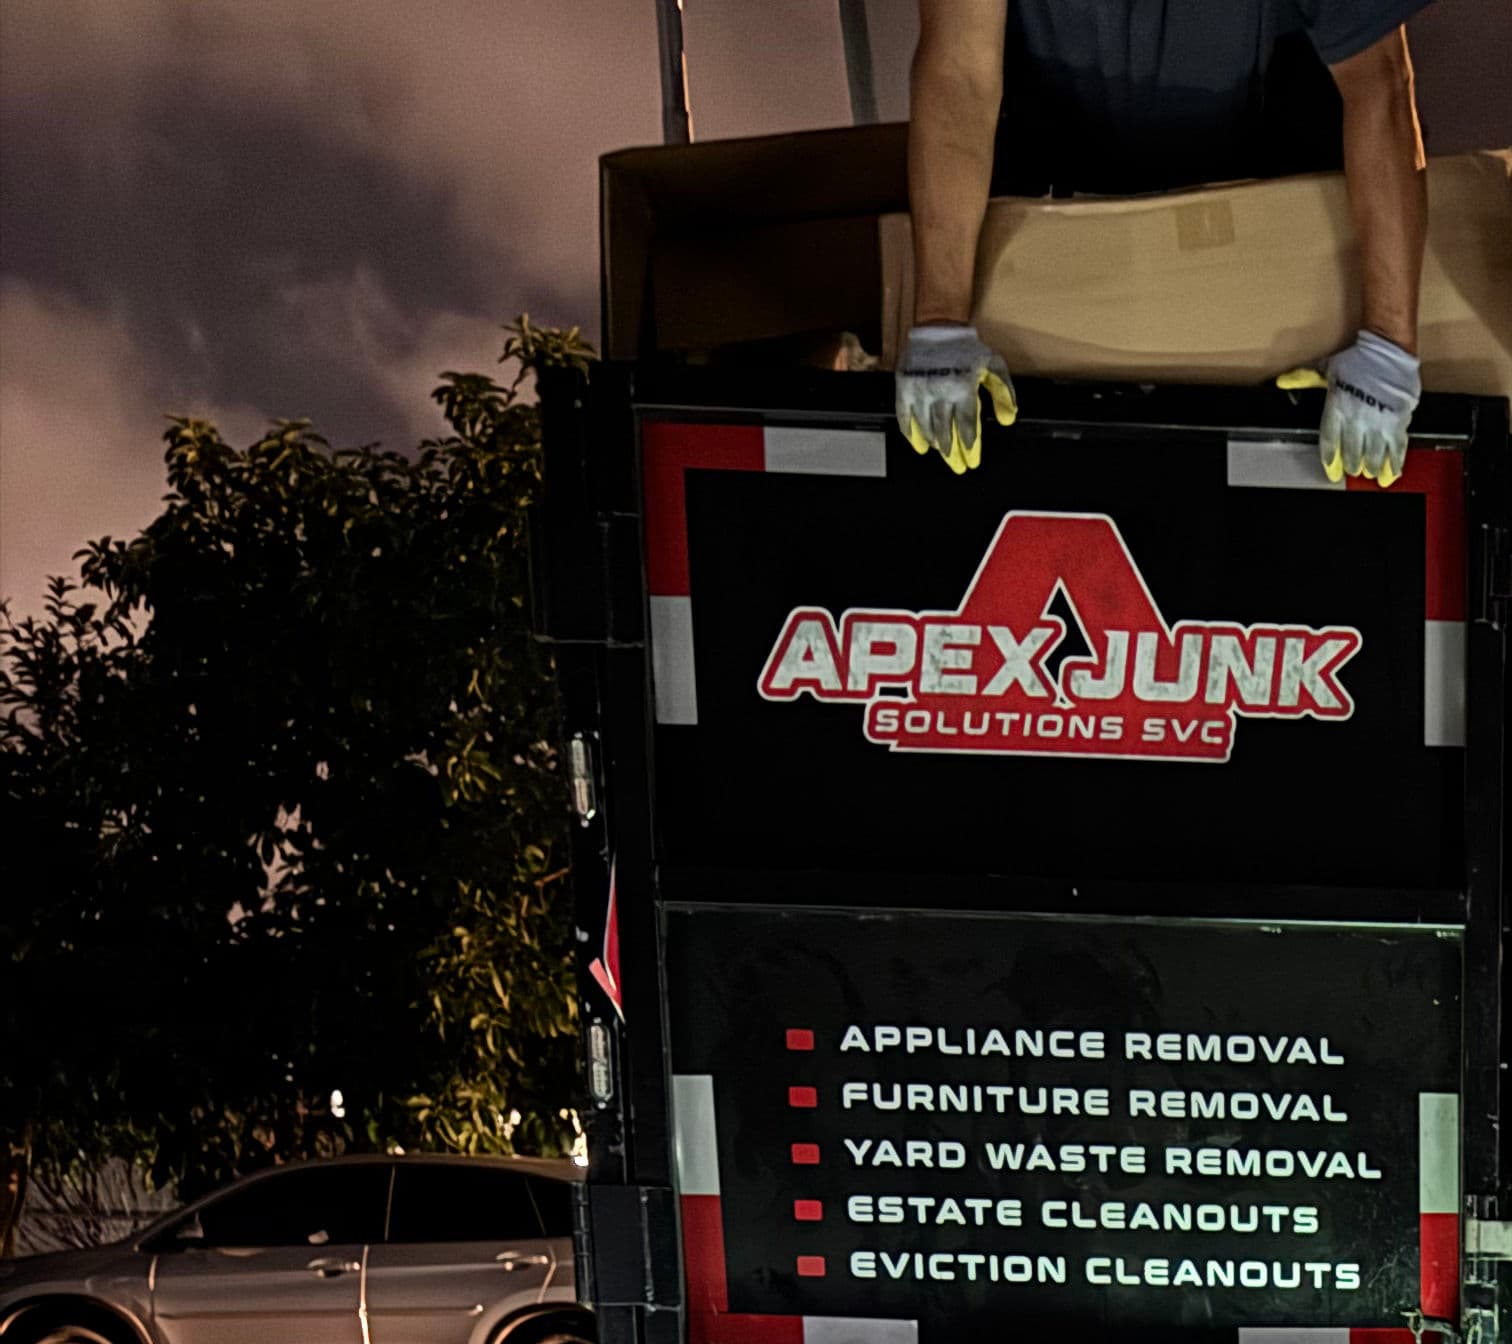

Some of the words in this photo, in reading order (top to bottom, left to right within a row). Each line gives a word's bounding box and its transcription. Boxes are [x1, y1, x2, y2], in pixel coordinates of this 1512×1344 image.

[769, 618, 1057, 697] APEX
[1069, 629, 1350, 708] JUNK
[875, 709, 1122, 741] SOLUTIONS
[1142, 719, 1224, 744] SVC
[840, 1026, 1104, 1058] APPLIANCE
[1126, 1033, 1344, 1064] REMOVAL
[843, 1083, 1109, 1115] FURNITURE
[1130, 1090, 1347, 1121] REMOVAL
[844, 1139, 965, 1168] YARD
[986, 1143, 1145, 1173] WASTE
[1166, 1148, 1381, 1178] REMOVAL
[848, 1196, 1021, 1226] ESTATE
[1042, 1202, 1318, 1233] CLEANOUTS
[851, 1252, 1065, 1282] EVICTION
[1086, 1258, 1360, 1289] CLEANOUTS
